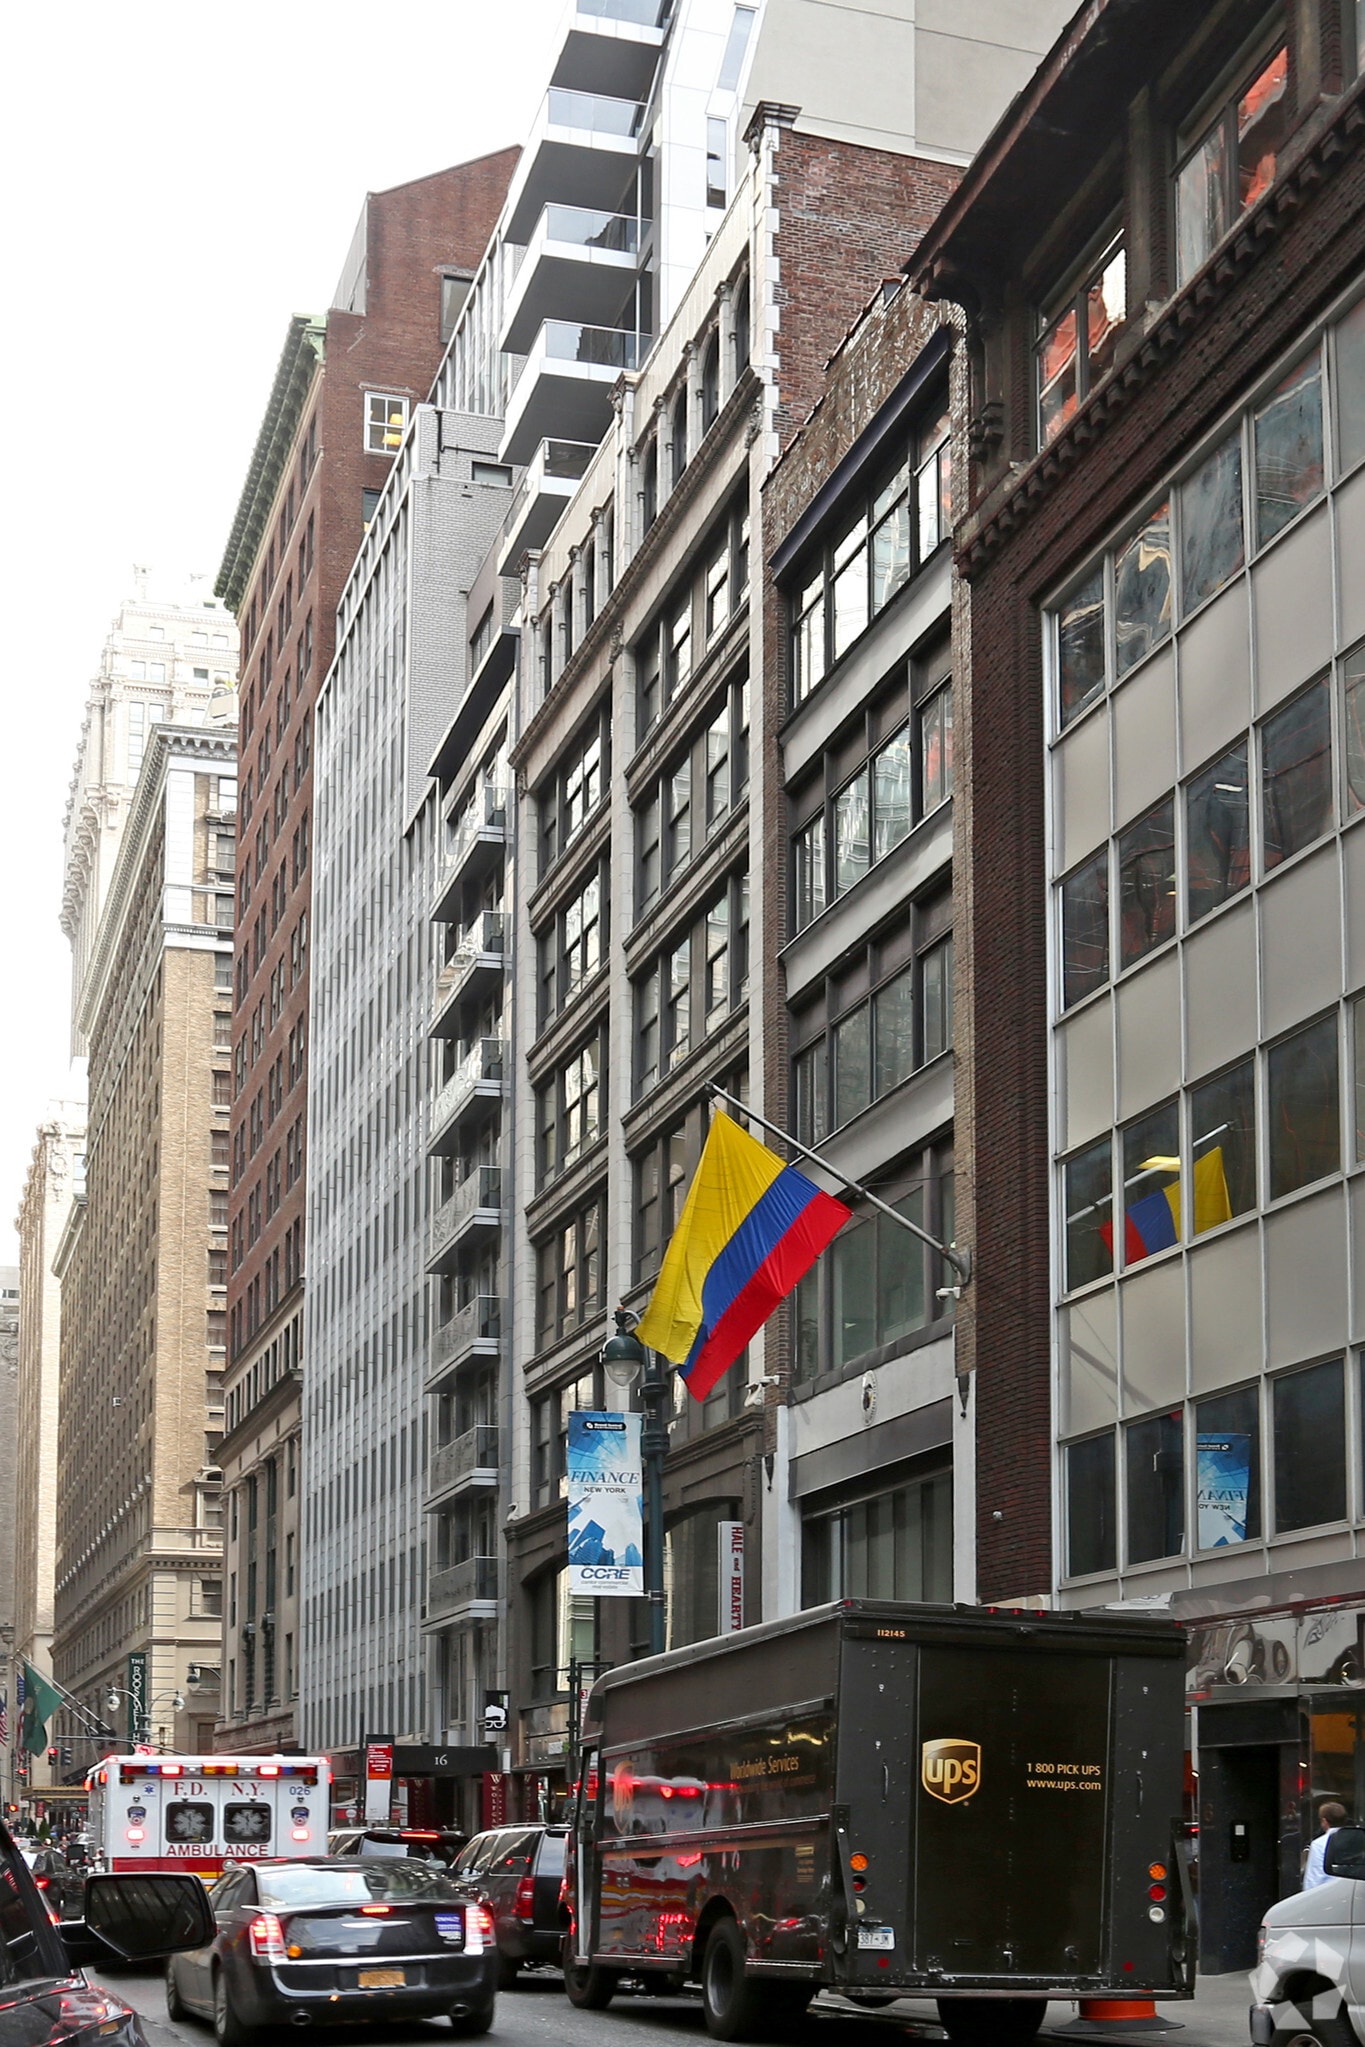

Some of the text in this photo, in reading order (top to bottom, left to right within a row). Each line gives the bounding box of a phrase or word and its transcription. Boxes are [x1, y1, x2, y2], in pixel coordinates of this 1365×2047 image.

[570, 1471, 640, 1485] FINANCE
[583, 1486, 602, 1494] NEW
[731, 1526, 744, 1554] HALE
[580, 1567, 632, 1580] CCRE
[731, 1576, 743, 1632] HEARTY
[877, 1629, 906, 1638] 112145
[434, 1753, 449, 1766] 16
[730, 1752, 800, 1781] Worldwide Services
[1026, 1763, 1101, 1776] 1 800 PICK UPS
[926, 1758, 977, 1794] ups
[174, 1781, 208, 1796] F.D.
[289, 1785, 312, 1796] 026
[1026, 1780, 1102, 1792] www.ups.com
[166, 1843, 269, 1857] AMBULANCE
